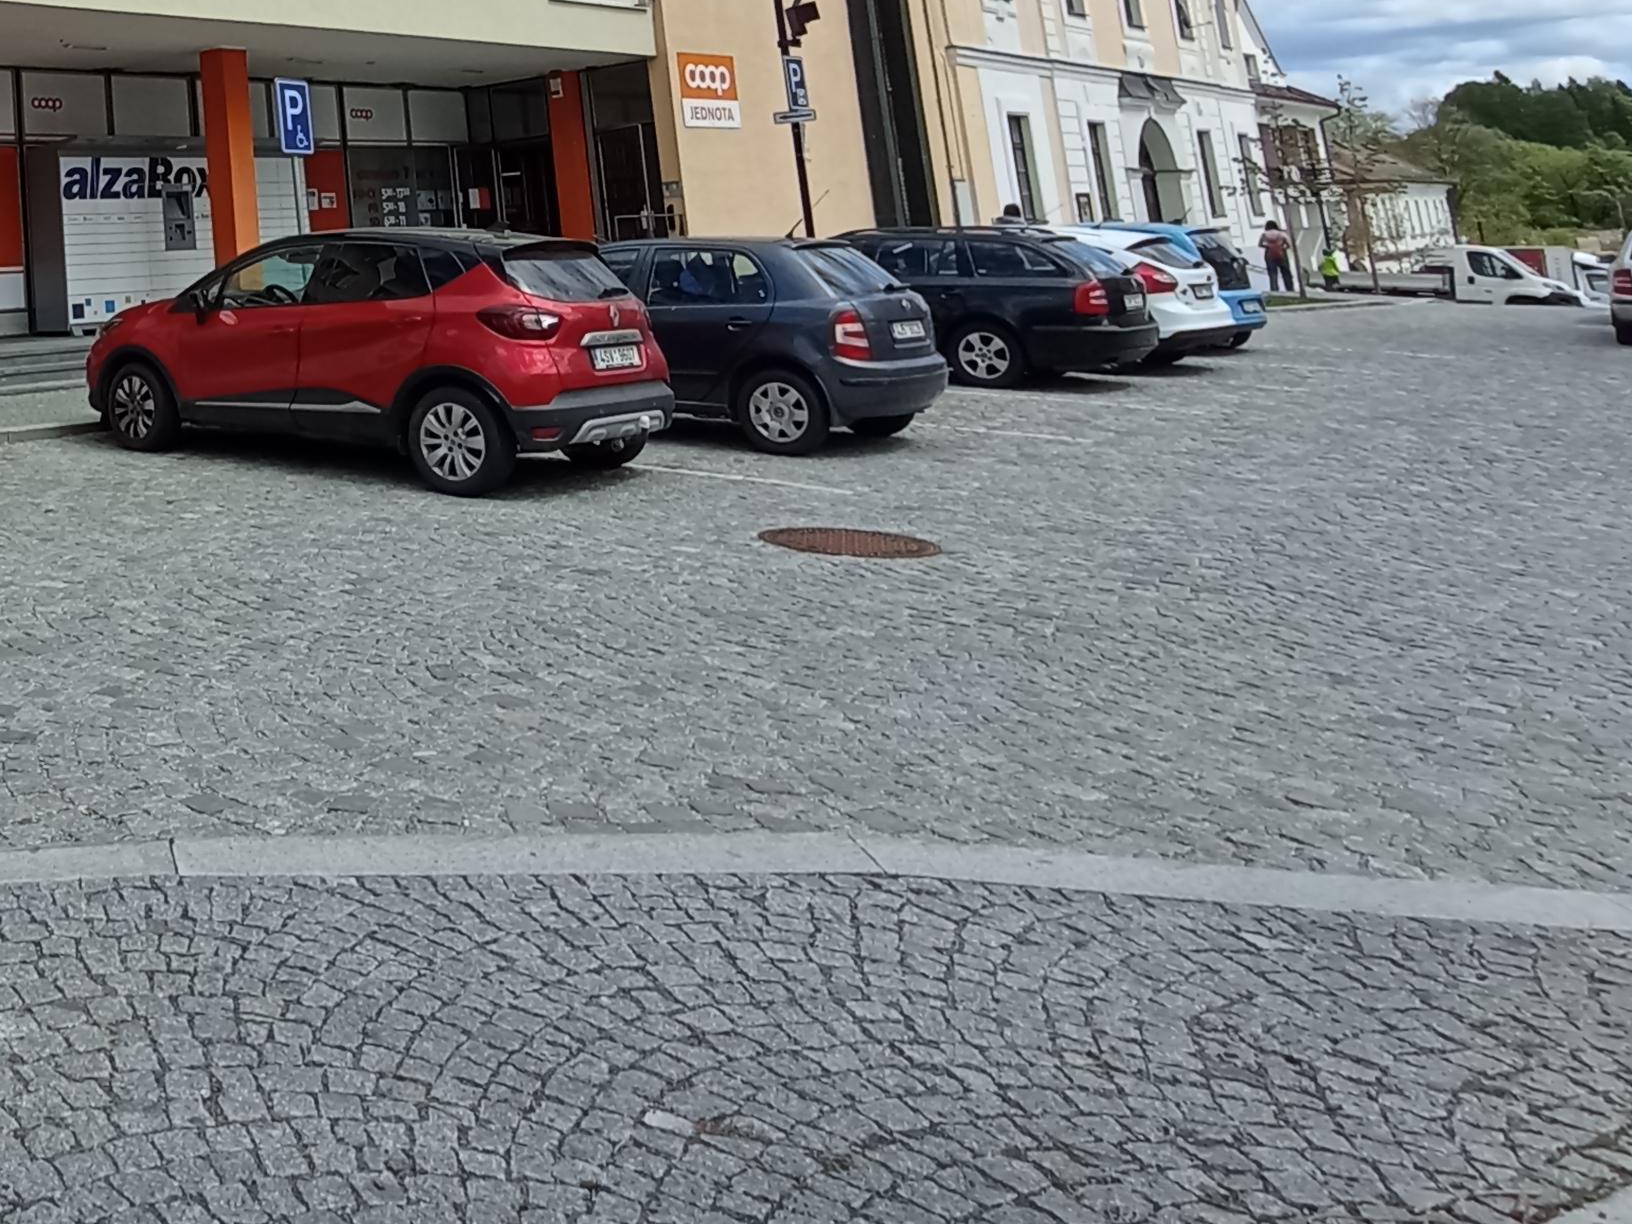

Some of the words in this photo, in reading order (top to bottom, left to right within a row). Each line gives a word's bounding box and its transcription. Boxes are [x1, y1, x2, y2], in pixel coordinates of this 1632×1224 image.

[684, 63, 731, 96] coop
[788, 62, 801, 93] P
[31, 97, 63, 112] coop
[283, 89, 303, 131] P
[690, 106, 735, 122] JEDNOTA
[63, 157, 209, 200] alzaBox
